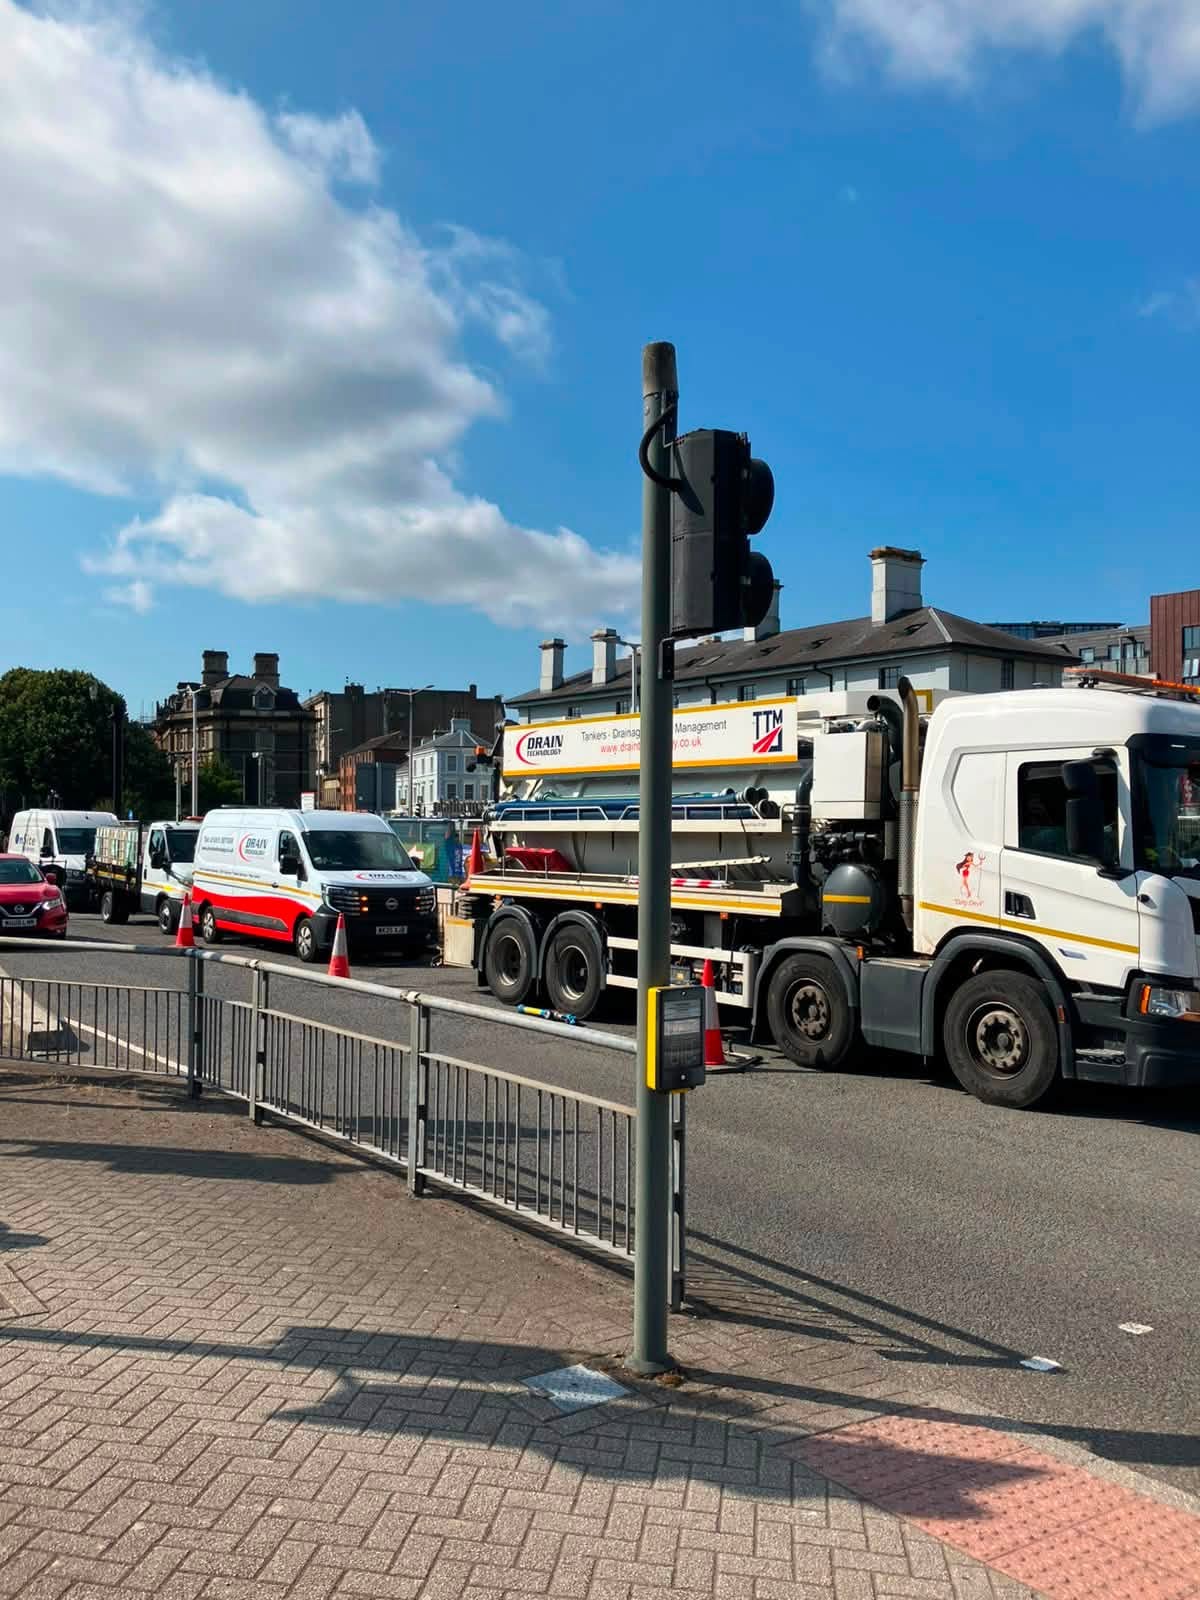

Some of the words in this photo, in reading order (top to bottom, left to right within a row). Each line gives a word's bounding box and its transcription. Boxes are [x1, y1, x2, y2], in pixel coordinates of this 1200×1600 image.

[581, 731, 607, 741] Tankers
[613, 728, 641, 740] Drainag
[675, 720, 727, 734] Management
[752, 709, 783, 740] TTM
[527, 735, 564, 750] DRAIN
[527, 748, 561, 757] TECHNOLOGY
[245, 837, 269, 849] DRAIN
